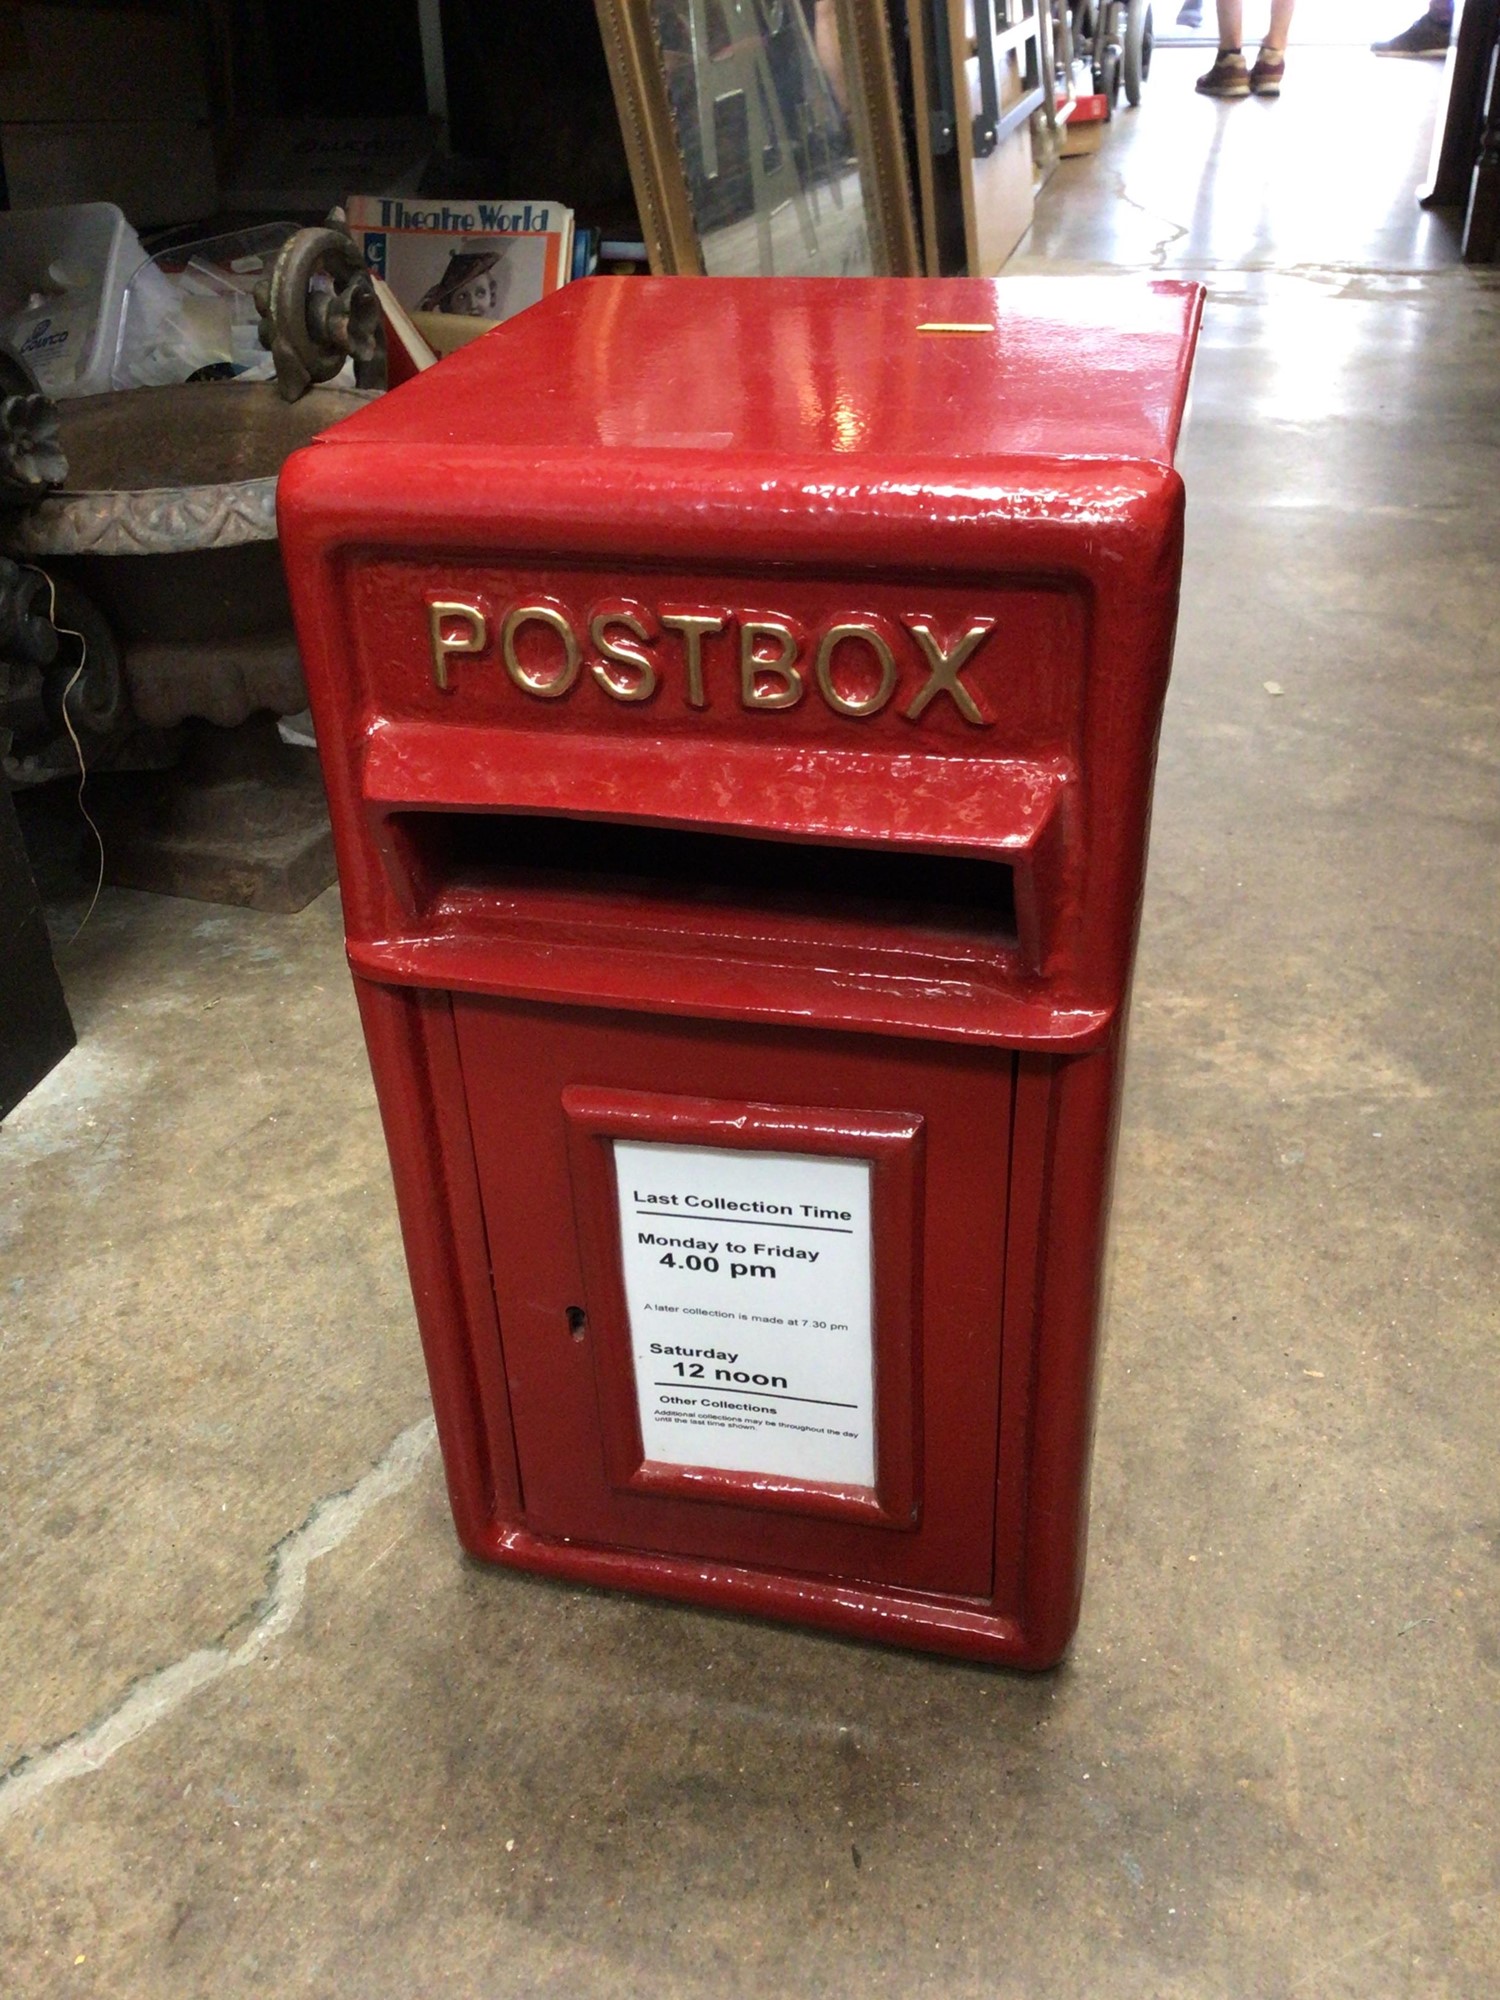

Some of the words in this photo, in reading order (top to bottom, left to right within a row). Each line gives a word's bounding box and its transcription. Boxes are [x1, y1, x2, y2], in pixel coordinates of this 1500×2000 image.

[379, 200, 474, 231] Theatre
[478, 205, 549, 231] World
[428, 598, 998, 726] POSTBOX
[633, 1190, 679, 1206] Last
[684, 1195, 793, 1216] Collection
[799, 1204, 852, 1221] Time
[637, 1232, 719, 1254] Monday
[725, 1241, 747, 1254] to
[753, 1243, 820, 1263] Friday
[658, 1252, 720, 1273] 4.00
[730, 1262, 777, 1279] pm
[643, 1303, 653, 1311] A
[654, 1304, 680, 1313] later
[682, 1306, 735, 1320] collection
[738, 1312, 748, 1321] is
[751, 1314, 784, 1325] made
[787, 1318, 798, 1327] at
[830, 1322, 849, 1332] pm
[650, 1343, 739, 1364] Saturday
[673, 1361, 705, 1379] 12
[715, 1368, 788, 1389] noon
[659, 1395, 698, 1406] Other
[700, 1398, 778, 1415] Collections
[653, 1409, 696, 1418] Additional
[698, 1413, 743, 1423] collections
[744, 1418, 763, 1426] may
[778, 1422, 825, 1436] throughout
[826, 1428, 841, 1436] the
[842, 1431, 859, 1440] day
